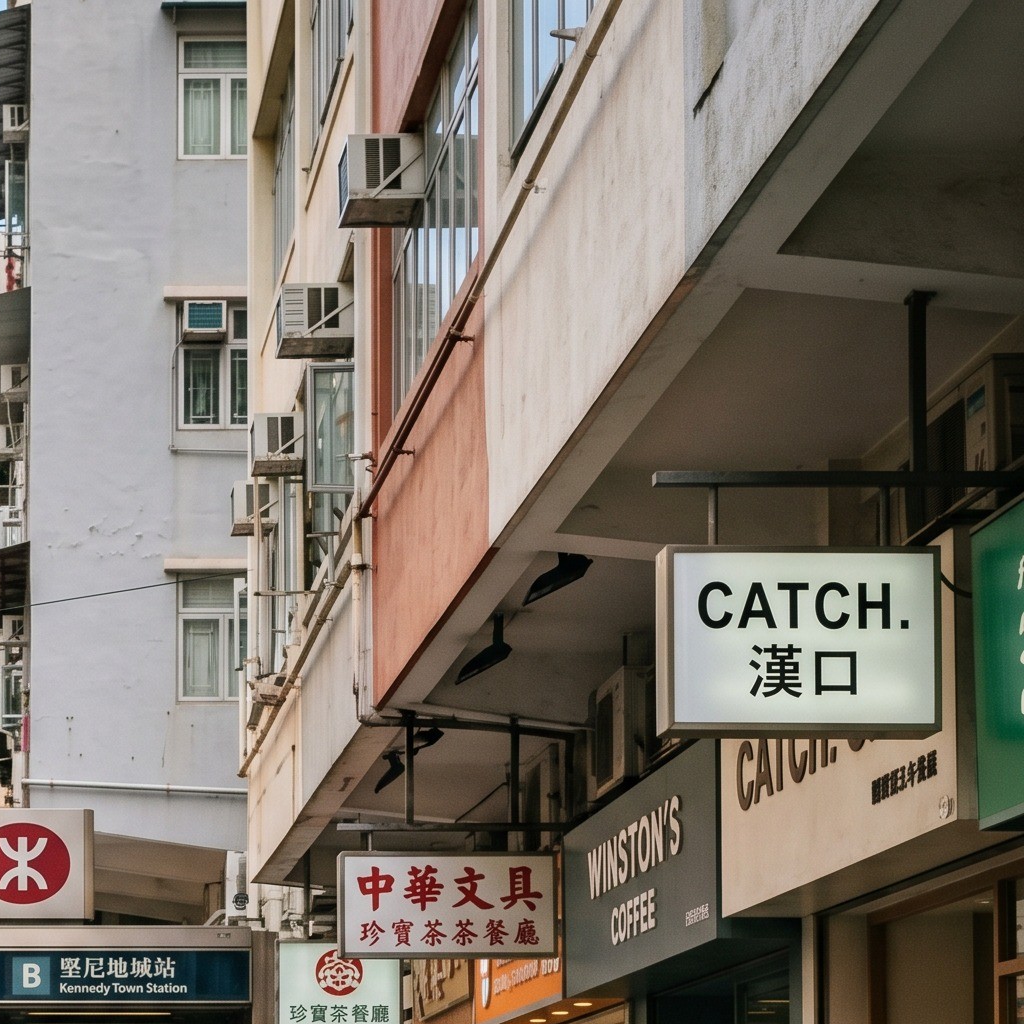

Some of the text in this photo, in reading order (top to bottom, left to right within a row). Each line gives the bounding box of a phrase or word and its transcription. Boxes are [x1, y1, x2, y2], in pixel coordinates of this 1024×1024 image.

[697, 581, 910, 630] CATCH.
[749, 643, 858, 698] 漢口
[587, 796, 680, 900] WINSTON'S
[357, 864, 543, 912] 中華文具
[360, 919, 539, 946] 珍寶茶茶餐廳
[610, 888, 657, 946] COFFEE
[22, 963, 41, 988] B
[60, 957, 176, 979] 堅尼地城站
[59, 982, 188, 996] Kennedy Town Station
[290, 1003, 391, 1024] 珍寶茶餐廳
